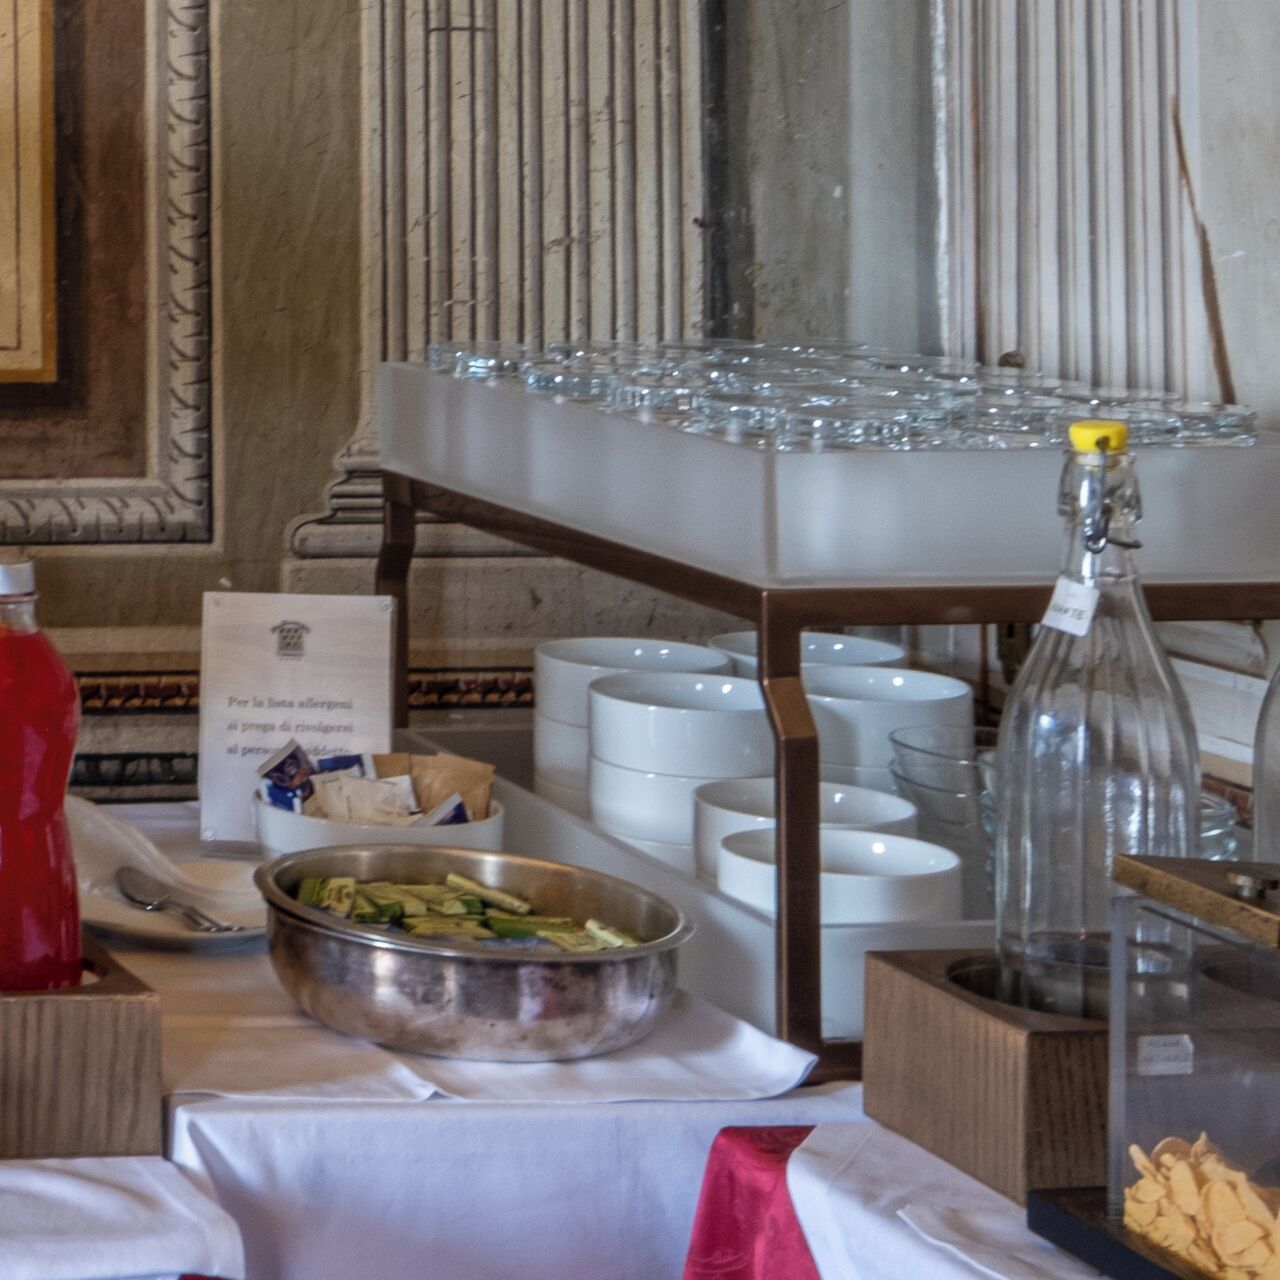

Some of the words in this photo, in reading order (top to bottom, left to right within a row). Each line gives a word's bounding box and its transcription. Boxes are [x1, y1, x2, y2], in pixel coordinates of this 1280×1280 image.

[227, 696, 249, 708] Per
[252, 696, 264, 708] la
[267, 697, 294, 708] lista
[297, 698, 353, 711] allergeni
[241, 722, 276, 734] prega
[279, 720, 291, 732] di
